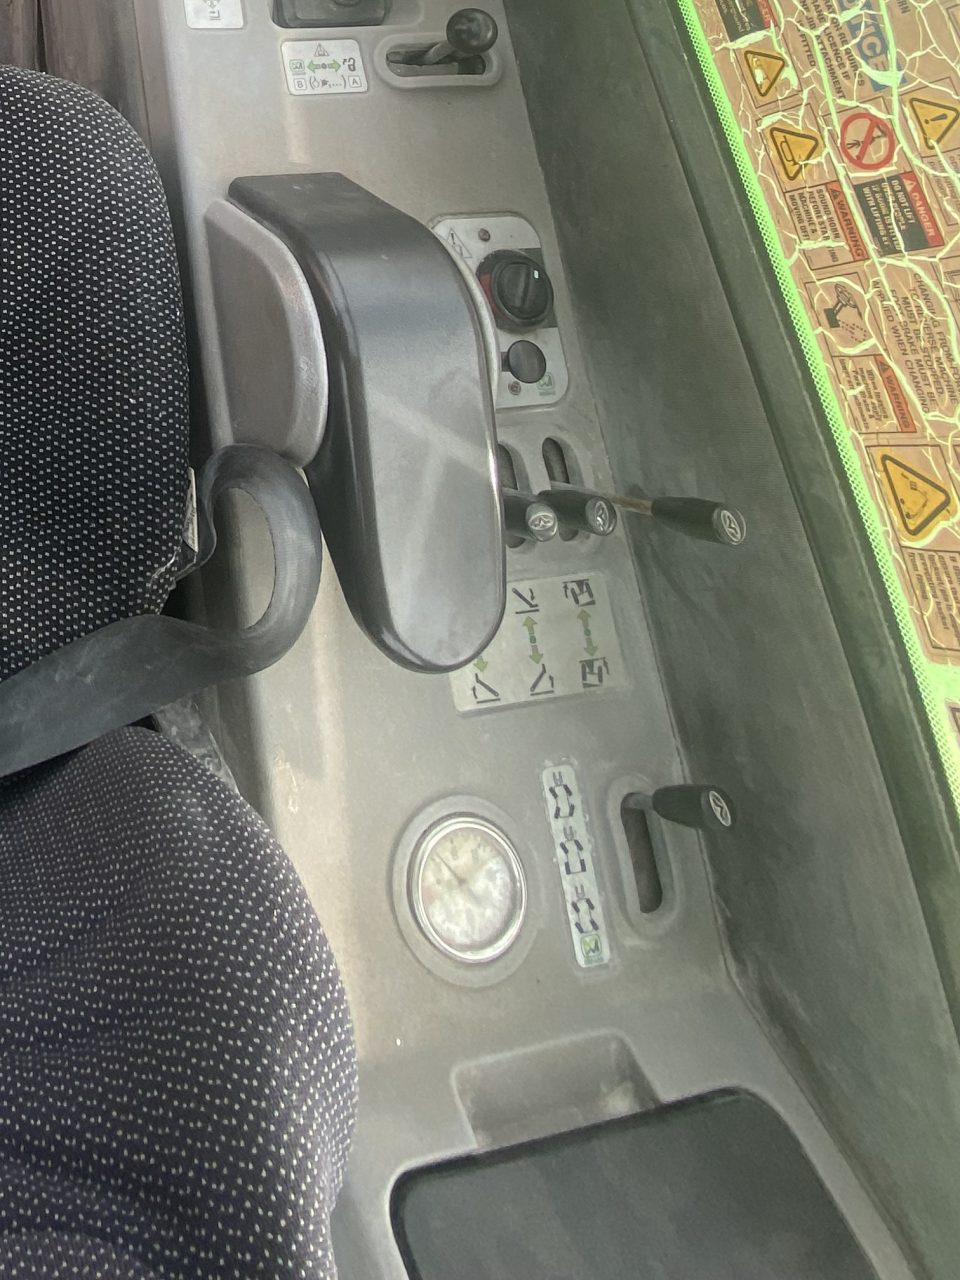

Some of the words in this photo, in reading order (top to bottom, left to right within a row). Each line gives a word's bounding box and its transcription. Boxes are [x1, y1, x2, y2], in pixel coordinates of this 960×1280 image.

[798, 33, 816, 67] FITTED
[814, 33, 845, 99] ATTACHMENT
[822, 25, 845, 70] LICENCE
[841, 70, 850, 81] IF
[788, 194, 804, 224] MOVING
[797, 192, 815, 226] MACHINE
[816, 188, 832, 215] SOUND
[826, 216, 840, 239] HORN
[862, 187, 875, 206] WITH
[891, 179, 901, 190] DO
[896, 191, 908, 206] NOT
[911, 192, 935, 236] DANGER
[806, 190, 823, 219] BEFORE
[817, 220, 839, 262] STARING
[835, 200, 864, 256] WARNING
[900, 296, 918, 325] MUST
[889, 325, 909, 356] WHEN
[884, 376, 910, 427] WARNING
[913, 358, 932, 387] MUST
[926, 391, 939, 405] BE
[933, 356, 959, 403] MACHINE
